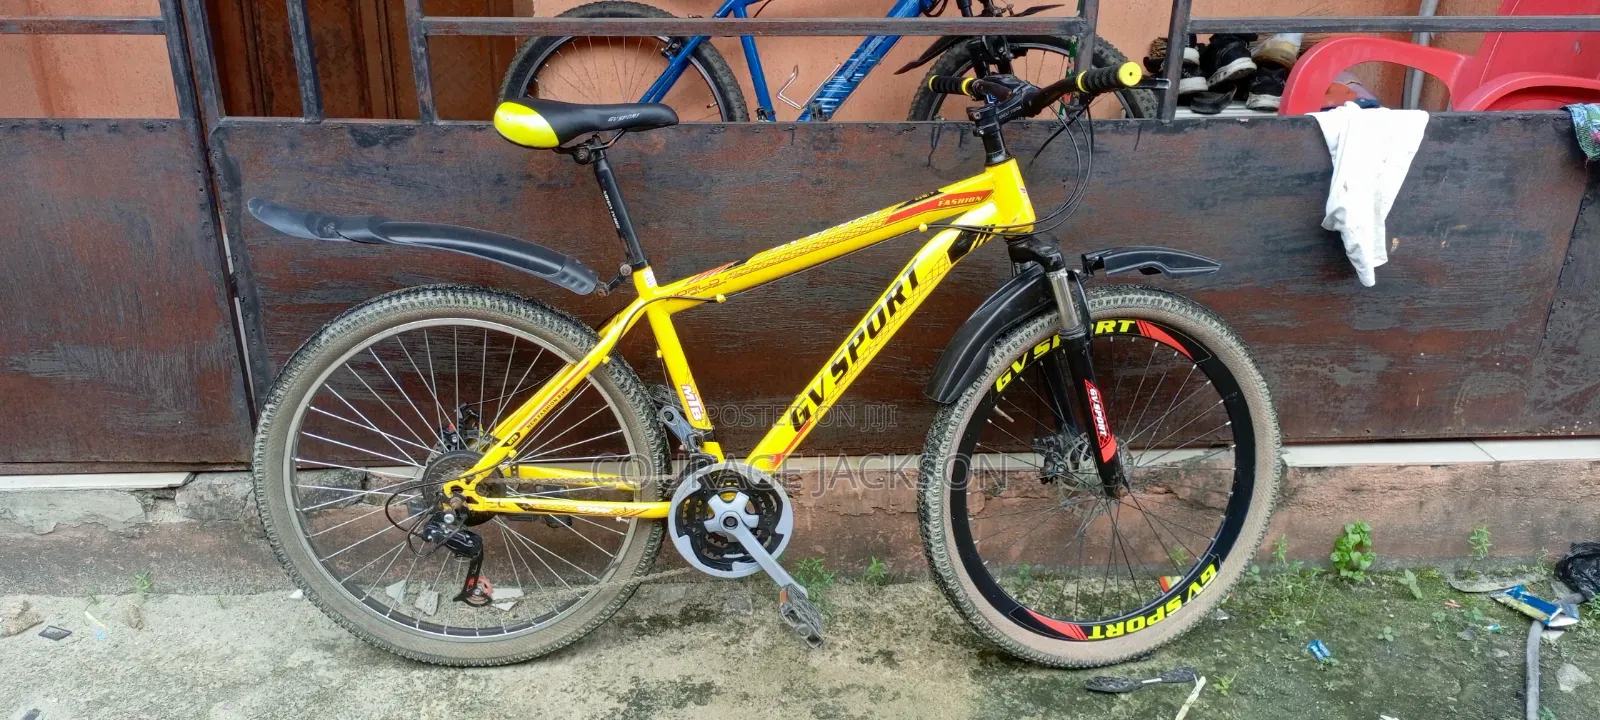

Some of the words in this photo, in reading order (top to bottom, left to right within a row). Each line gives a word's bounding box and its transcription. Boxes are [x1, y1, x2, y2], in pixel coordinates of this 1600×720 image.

[937, 195, 984, 207] FASHION
[790, 375, 825, 432] GV
[830, 258, 920, 385] SPORT
[995, 351, 1029, 393] GV
[526, 417, 538, 429] NEW
[537, 398, 558, 419] FASHION
[558, 387, 570, 399] BIKE
[680, 384, 704, 421] MTB
[1187, 563, 1218, 603] GV
[1087, 594, 1183, 640] SPORT
